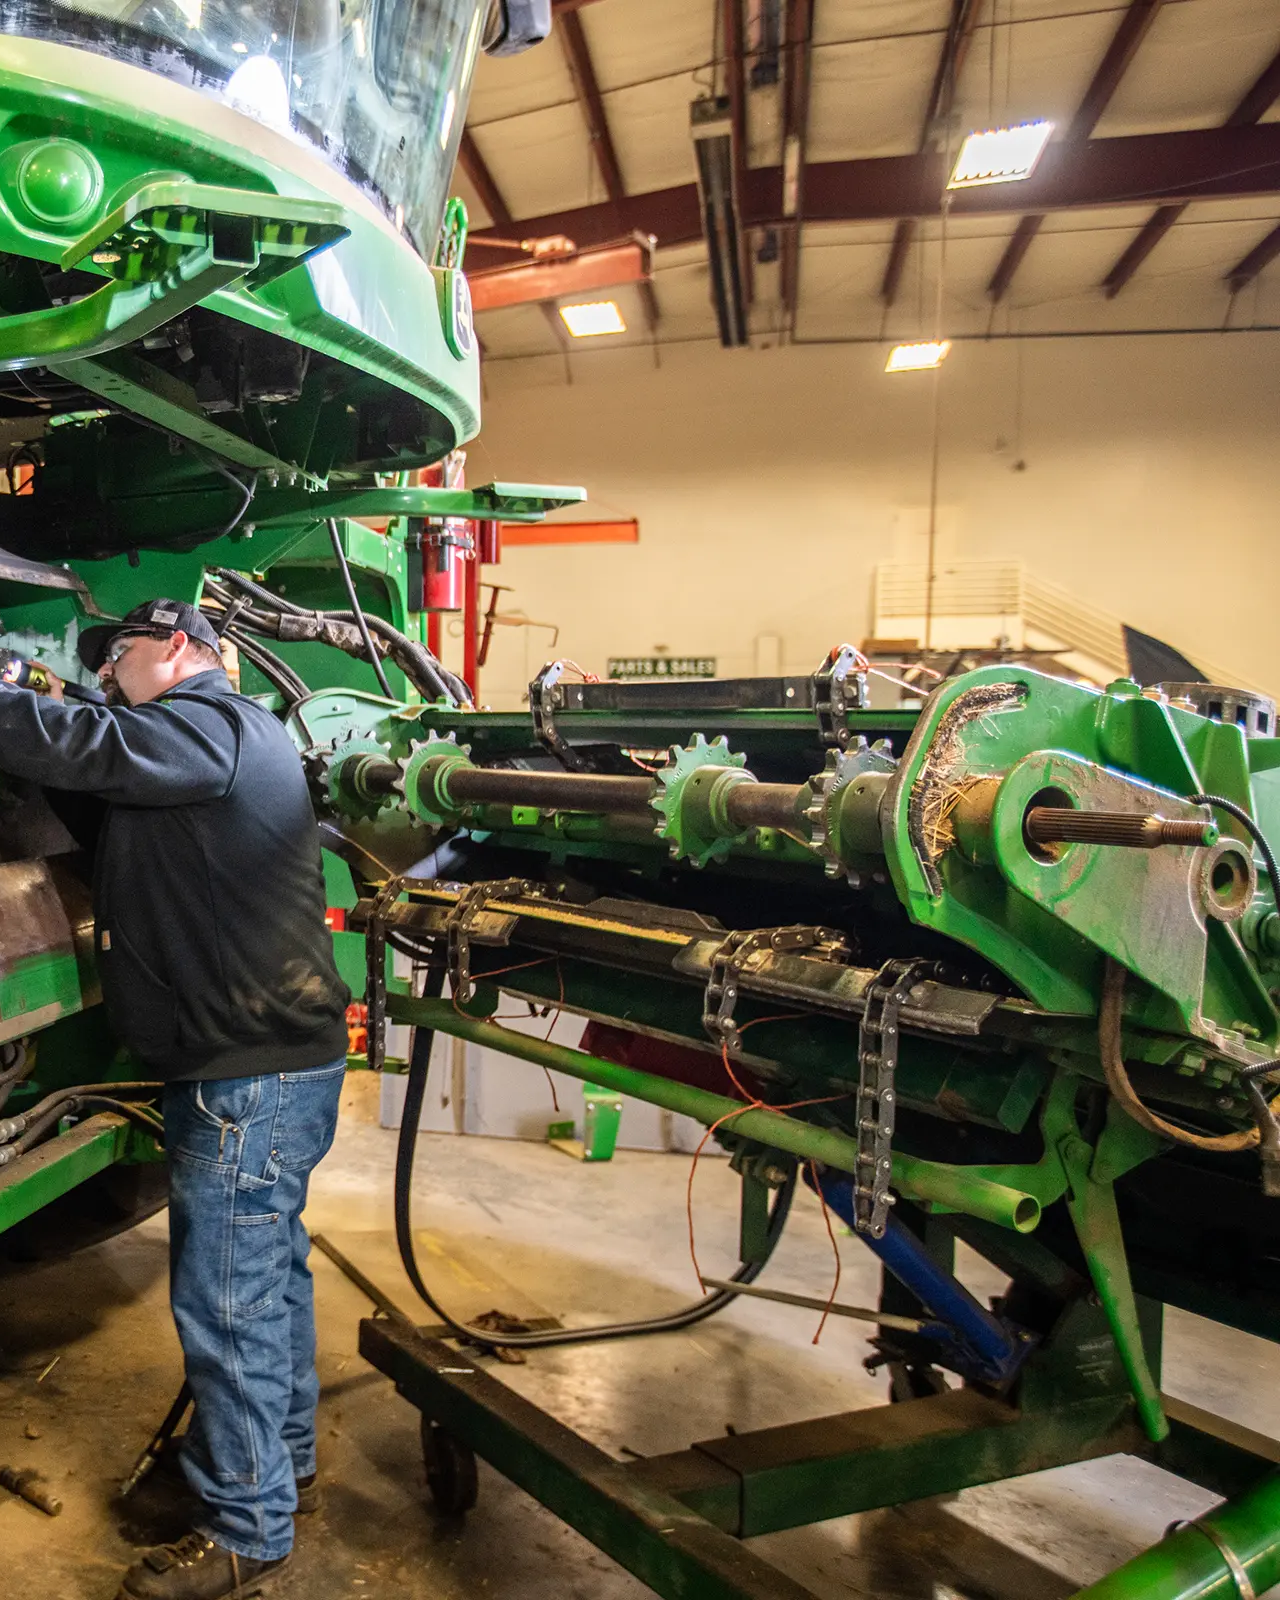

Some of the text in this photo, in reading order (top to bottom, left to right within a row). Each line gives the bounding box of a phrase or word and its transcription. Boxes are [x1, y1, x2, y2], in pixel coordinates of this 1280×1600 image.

[610, 661, 714, 674] PARTS & SALES
